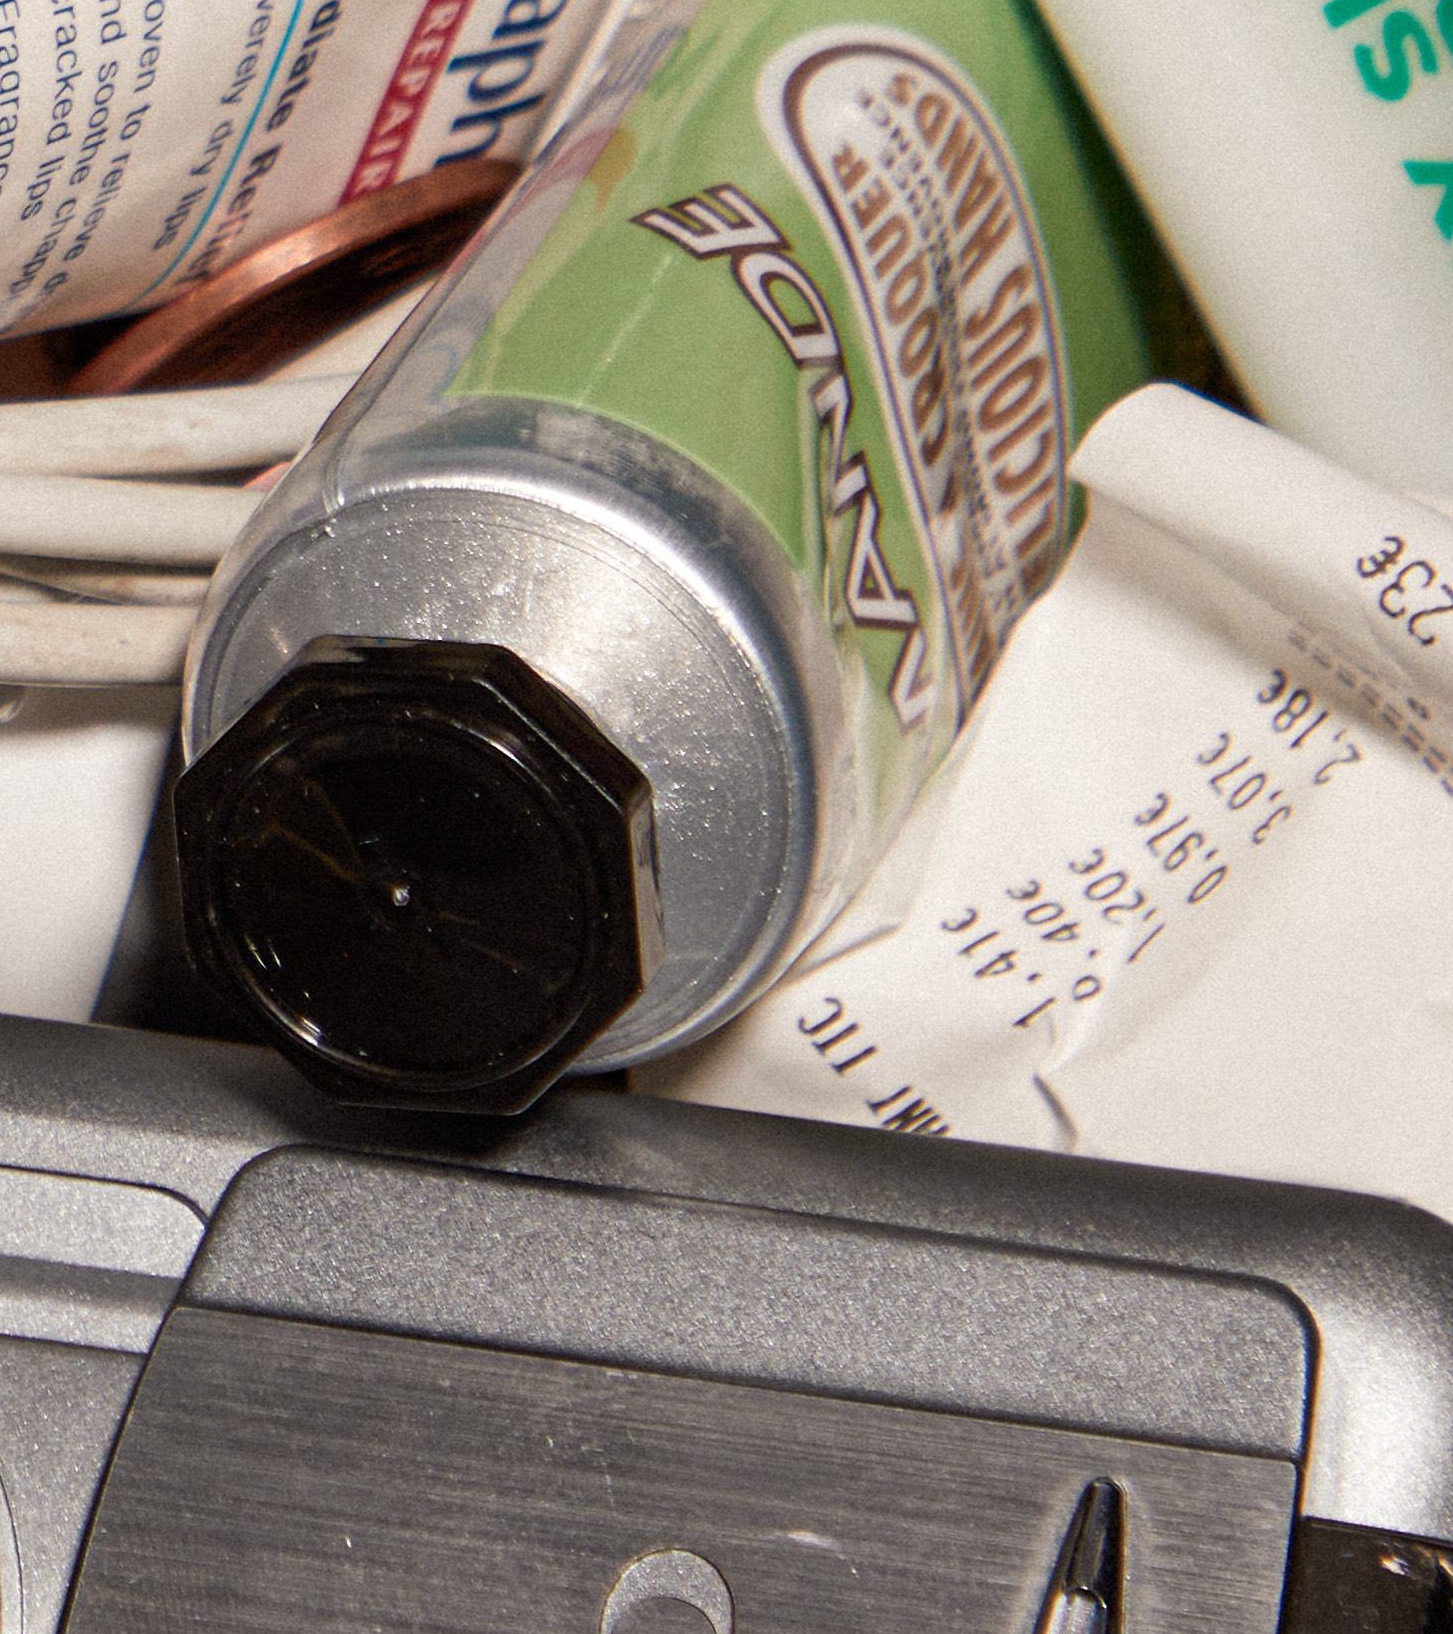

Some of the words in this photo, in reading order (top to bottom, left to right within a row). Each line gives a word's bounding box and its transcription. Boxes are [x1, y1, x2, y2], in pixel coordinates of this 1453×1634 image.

[68, 57, 121, 188] soothe
[119, 101, 149, 142] to
[190, 118, 236, 183] dry
[342, 0, 461, 198] REPAIR
[19, 152, 66, 223] lips
[64, 151, 132, 264] relieve
[152, 182, 206, 252] lips
[890, 71, 1021, 291] HANDS
[6, 190, 81, 302] chapp
[829, 140, 953, 470] CROQUER
[1255, 666, 1364, 786] 2,18€
[1195, 730, 1294, 847] 3,07€
[1066, 846, 1167, 965] 1,20€
[1132, 791, 1232, 905] 0,97€
[939, 906, 1056, 1029] 1,41€
[796, 996, 880, 1077] TTC
